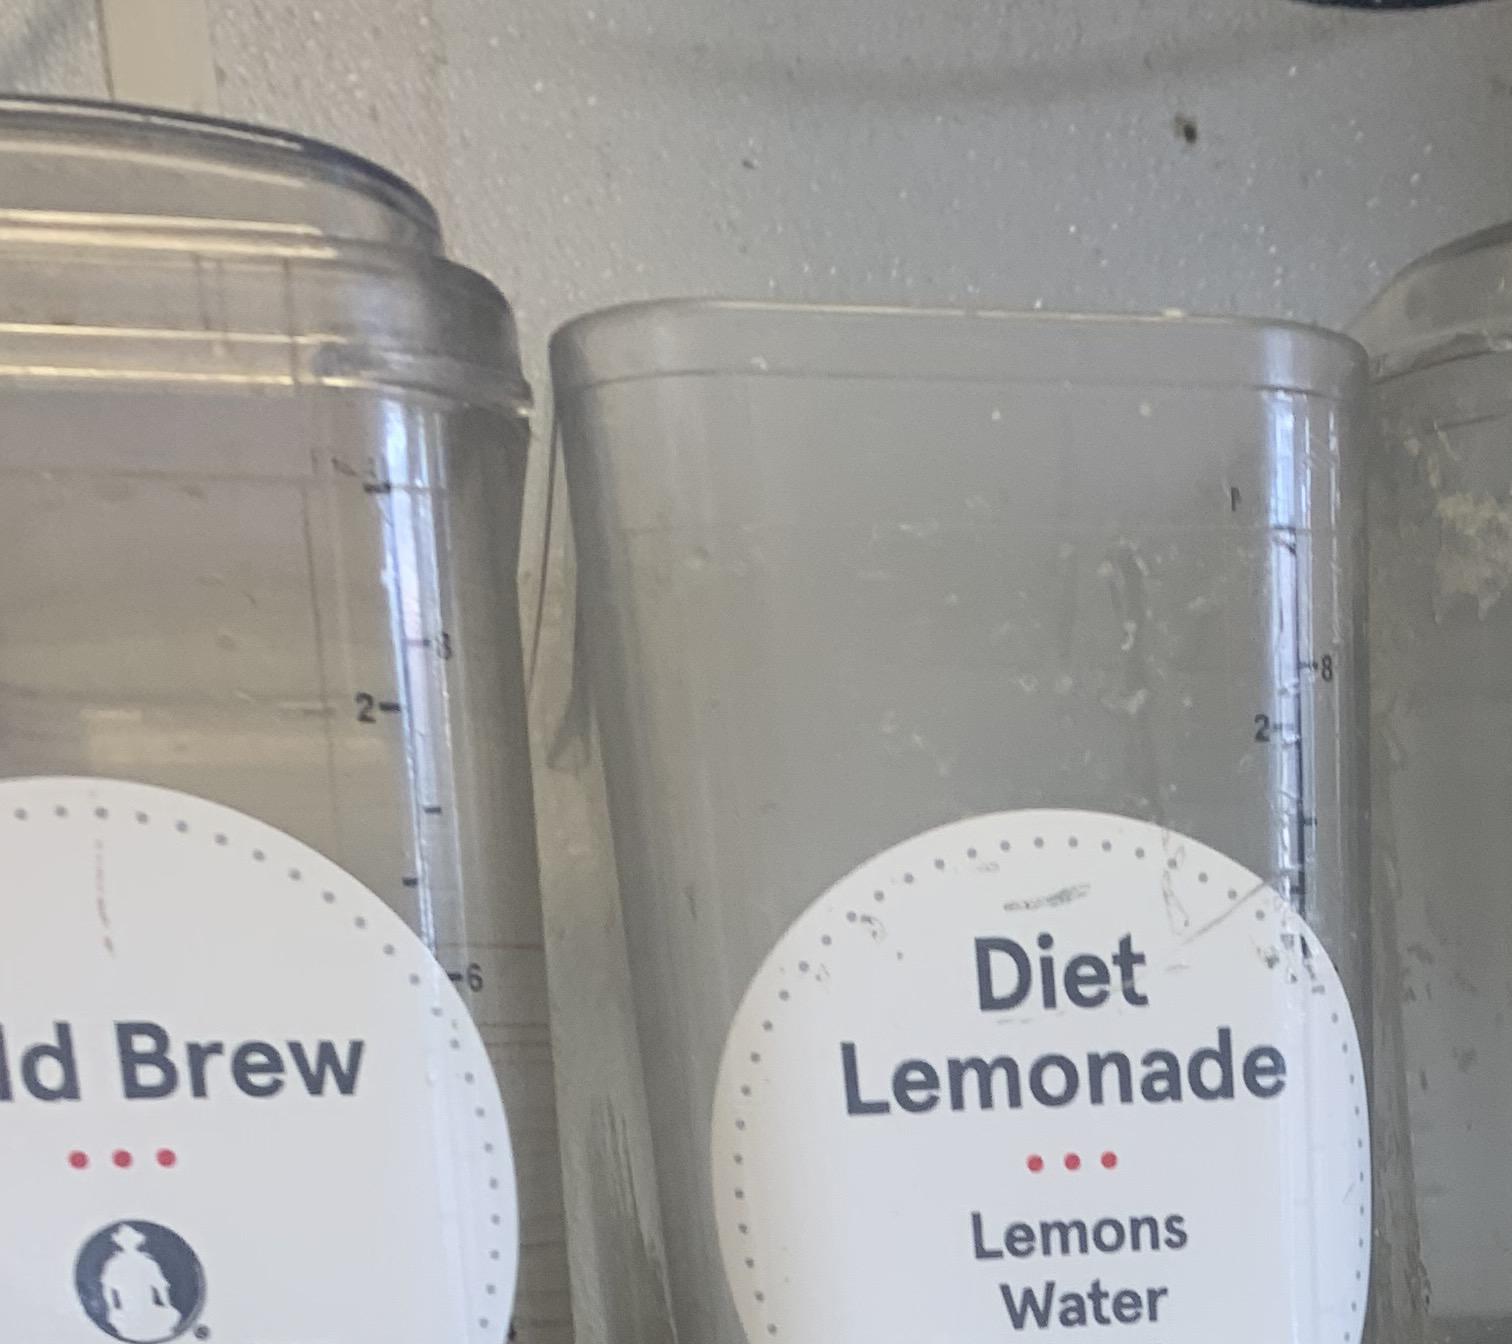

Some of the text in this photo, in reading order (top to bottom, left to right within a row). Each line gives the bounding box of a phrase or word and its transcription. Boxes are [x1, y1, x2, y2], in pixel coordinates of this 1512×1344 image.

[1321, 654, 1333, 682] 8
[356, 692, 377, 724] 2
[1254, 714, 1271, 743] 2
[466, 962, 484, 991] 6
[974, 932, 1149, 1012] Diet
[114, 1020, 365, 1099] Brew
[840, 1027, 1287, 1116] Lemonade
[971, 1210, 1188, 1261] Lemons
[1000, 1281, 1169, 1330] Water
